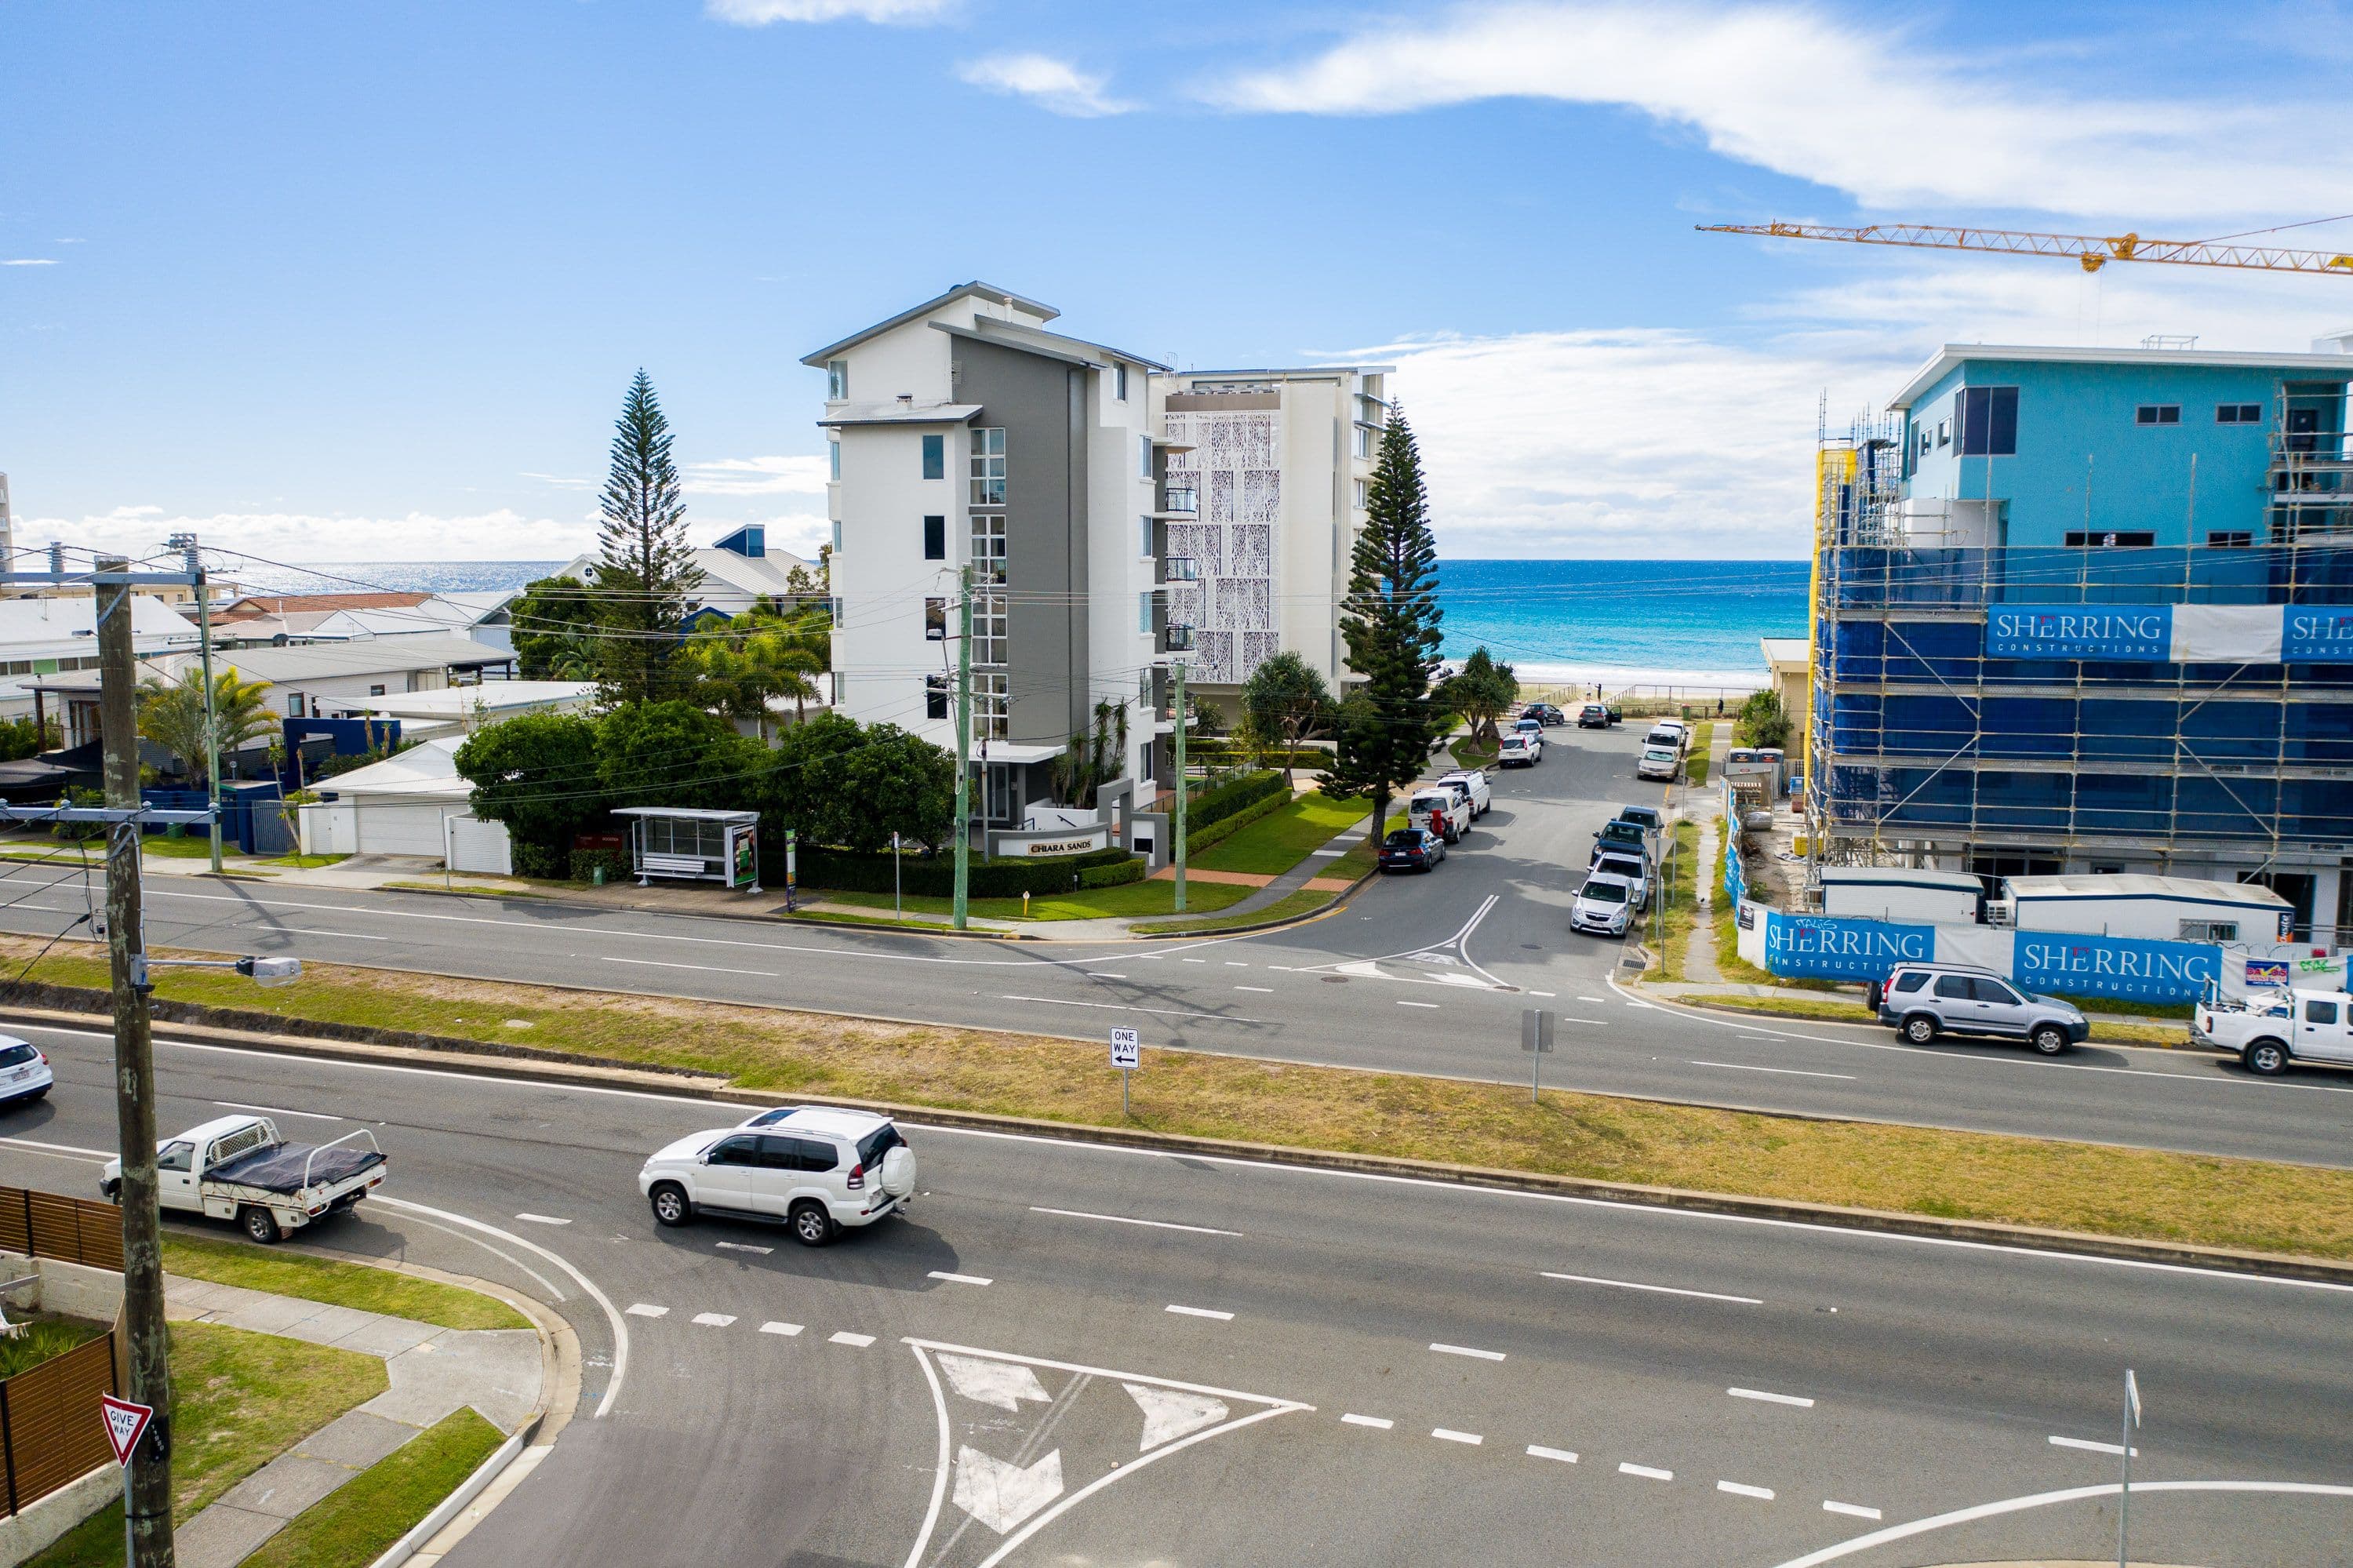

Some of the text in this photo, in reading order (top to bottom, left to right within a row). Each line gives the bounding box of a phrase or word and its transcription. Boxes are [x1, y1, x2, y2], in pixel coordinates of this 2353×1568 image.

[1997, 614, 2161, 639] SHERRING
[1998, 643, 2158, 653] CONSTRUCTIONS
[1031, 841, 1091, 853] CHIARA SANDS
[1769, 924, 1923, 959] SHERRING
[2024, 944, 2209, 983] SHERRING
[1115, 1031, 1135, 1042] ONE
[1114, 1043, 1136, 1053] WAY
[111, 1410, 134, 1426] GIVE
[114, 1424, 130, 1436] WAY
